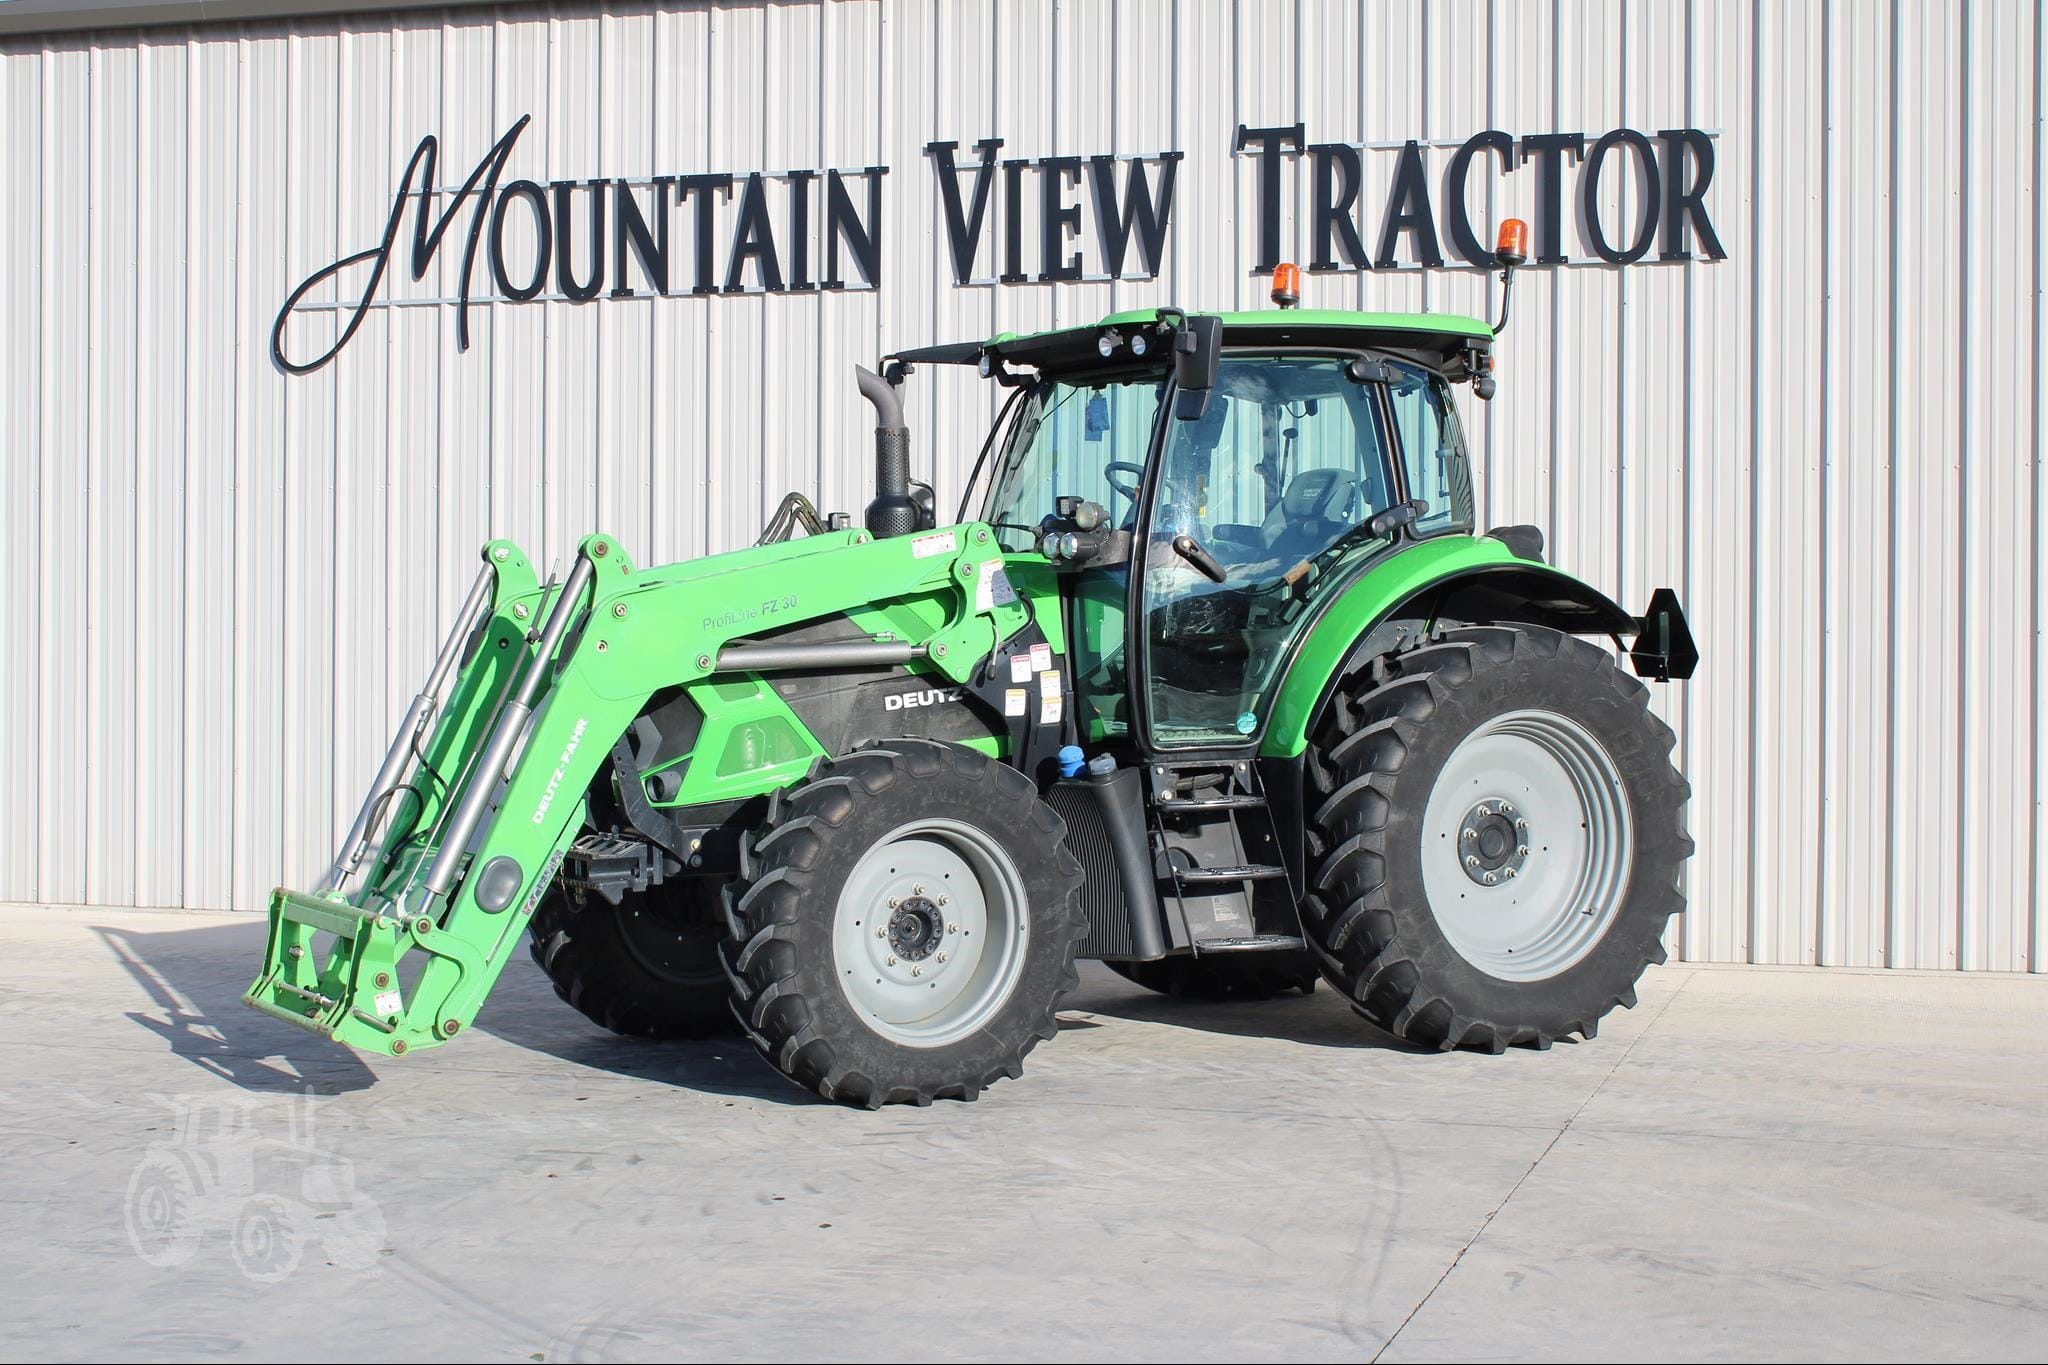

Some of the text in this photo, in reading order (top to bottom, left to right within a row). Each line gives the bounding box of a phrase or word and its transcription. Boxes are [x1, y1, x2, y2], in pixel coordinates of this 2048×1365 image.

[272, 114, 1727, 373] MOUNTAIN VIEW TRACTOR
[761, 600, 779, 616] FZ
[782, 594, 798, 610] 30
[884, 685, 964, 712] DEUTZ
